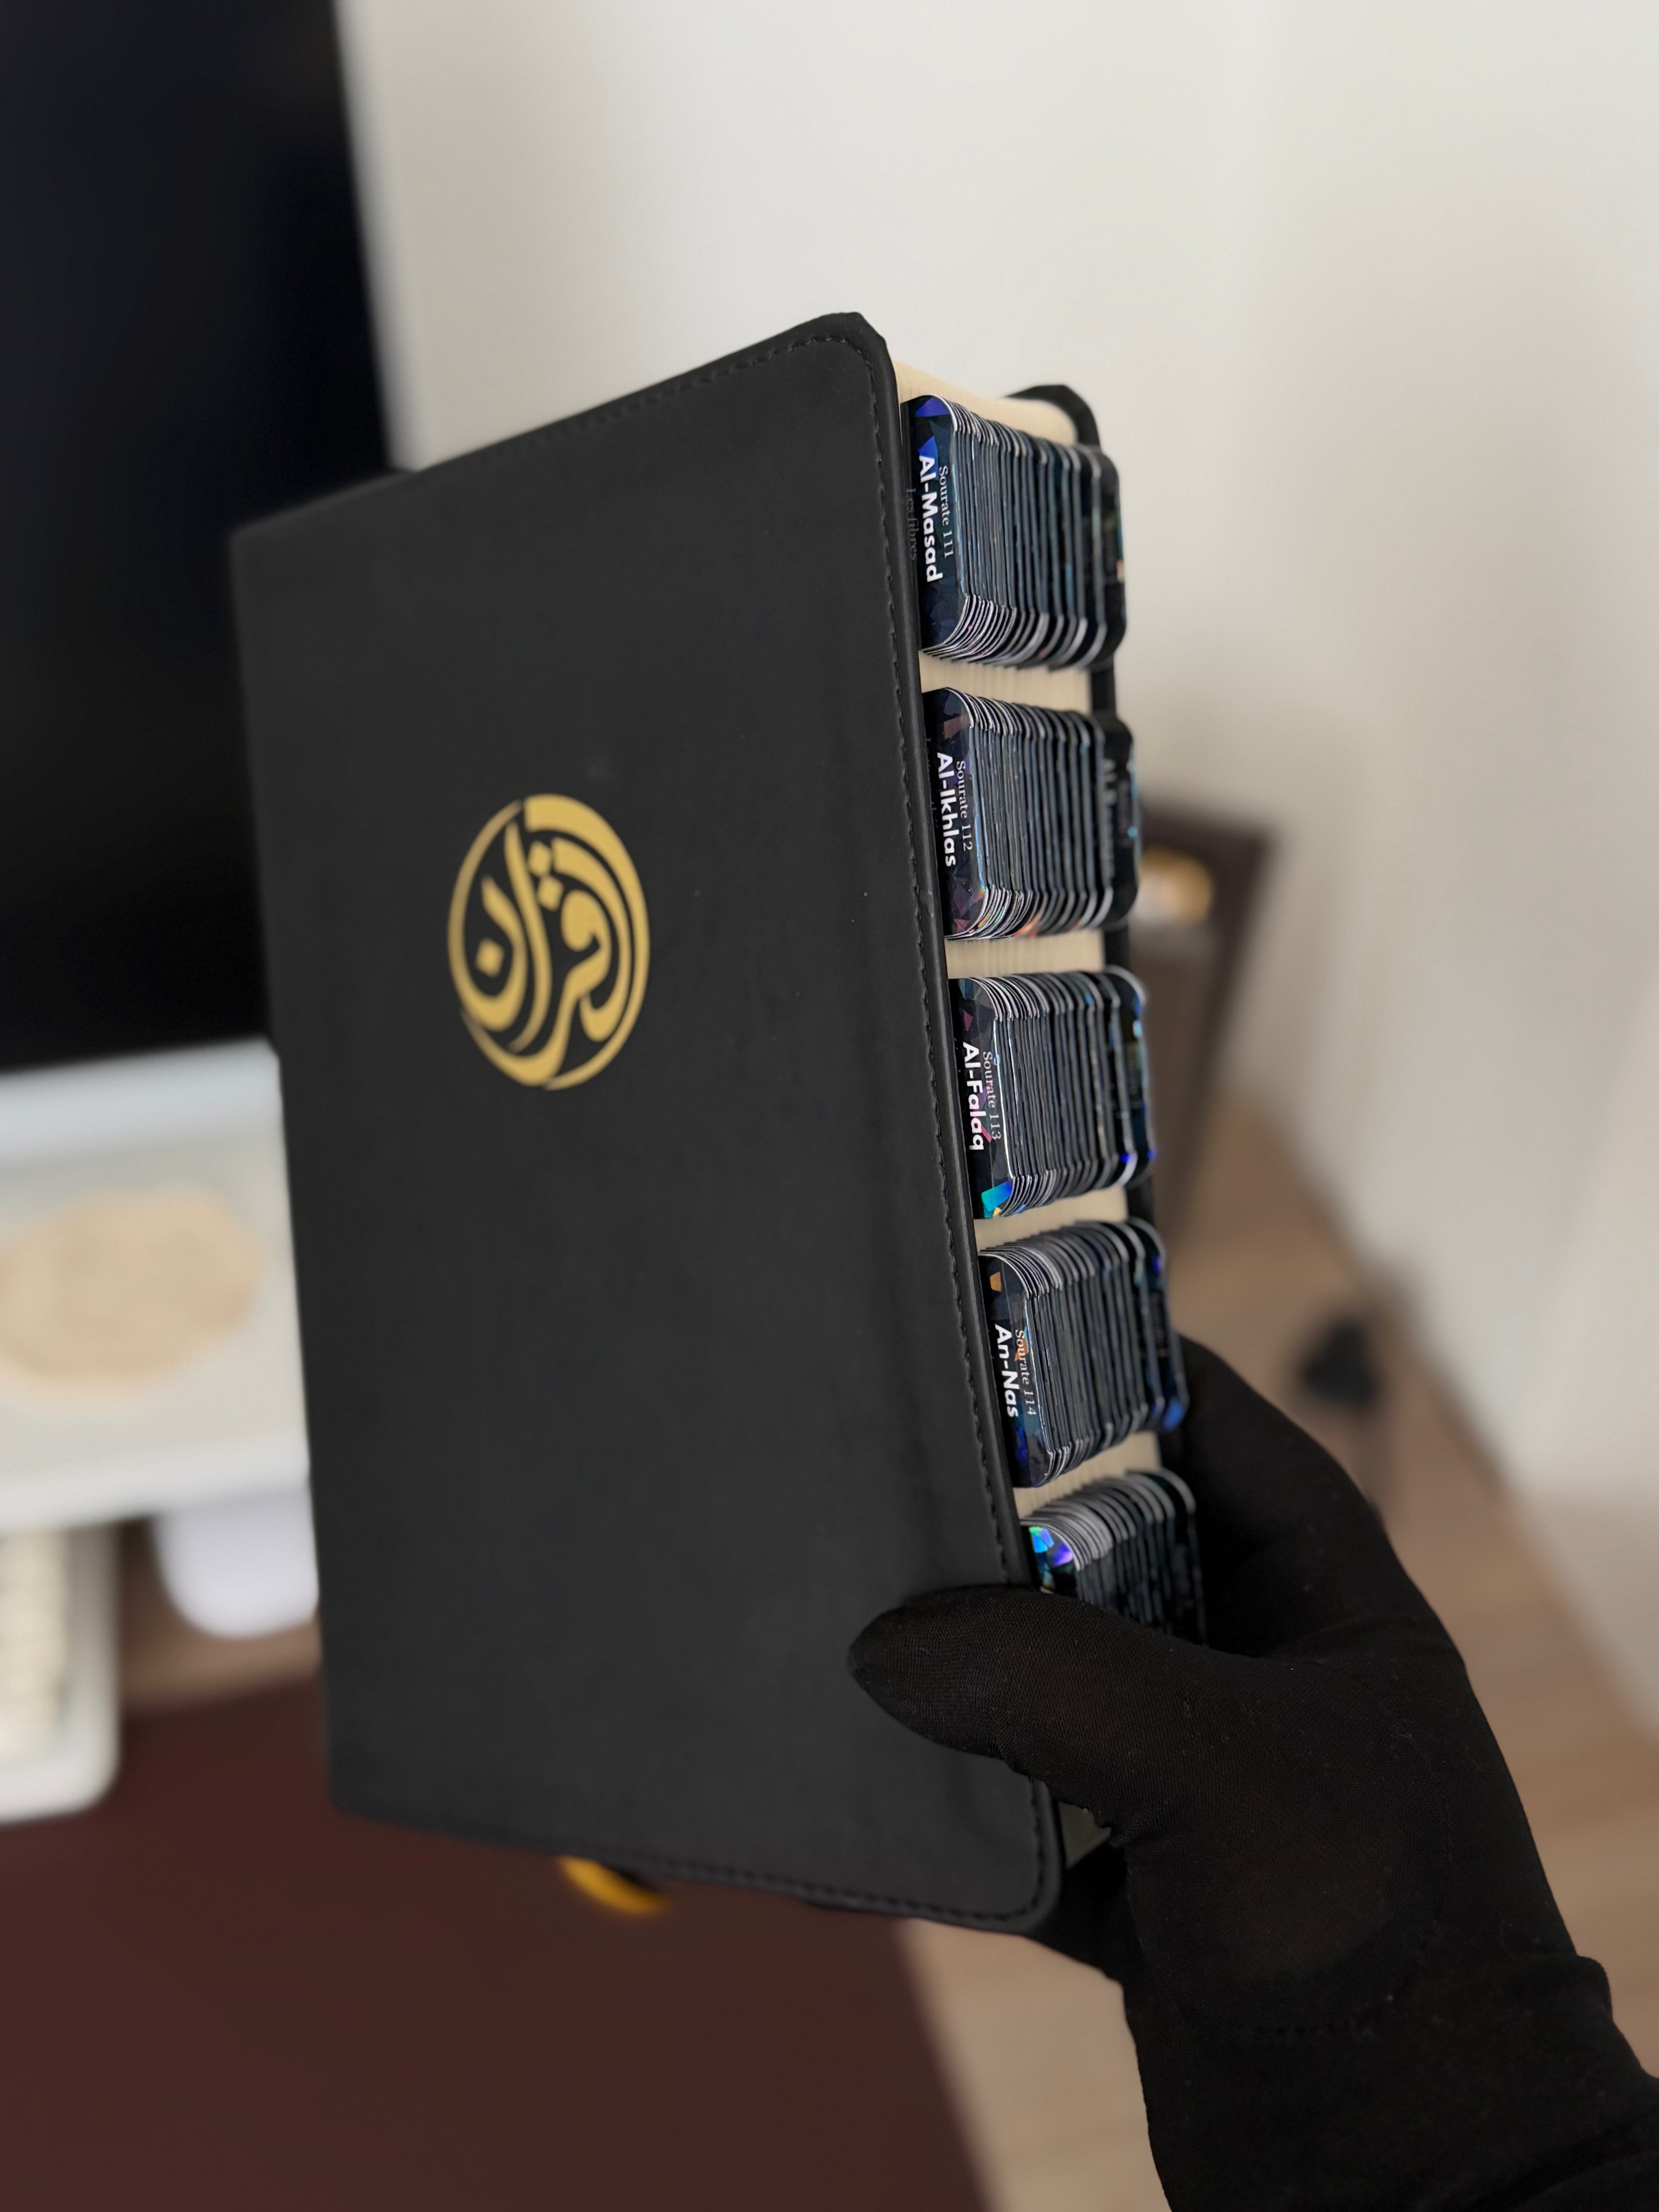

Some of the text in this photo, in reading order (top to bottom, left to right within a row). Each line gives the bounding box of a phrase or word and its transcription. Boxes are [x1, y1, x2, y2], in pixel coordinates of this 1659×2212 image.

[919, 455, 943, 582] Al-Masad
[939, 465, 954, 558] Sourate 111
[937, 752, 959, 867] Al-Ikhlas
[957, 761, 973, 852] Sourate 112
[963, 1042, 986, 1150] Al-Falaq
[983, 1051, 1001, 1140] Sourate 113
[995, 1324, 1020, 1418] An-Nas
[1015, 1329, 1036, 1415] Sourate 114
